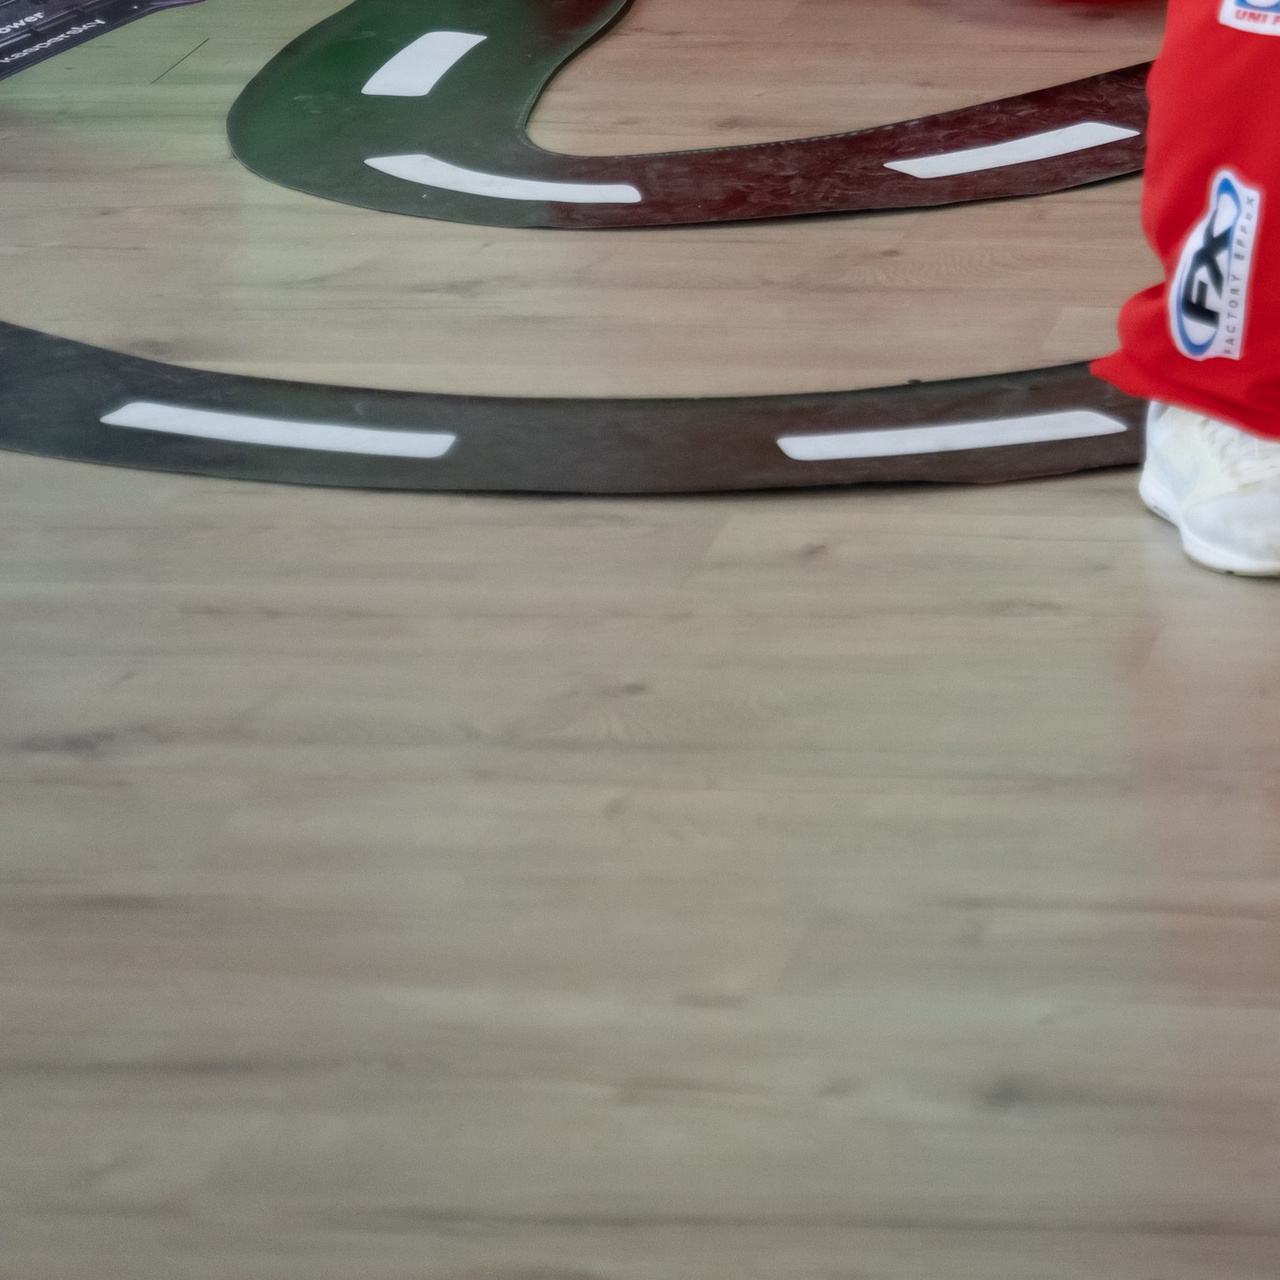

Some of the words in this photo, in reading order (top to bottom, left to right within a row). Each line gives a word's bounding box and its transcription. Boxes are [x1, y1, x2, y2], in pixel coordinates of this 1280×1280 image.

[1234, 9, 1268, 22] UNI
[1181, 210, 1234, 328] FX
[1223, 274, 1242, 355] FACTORY
